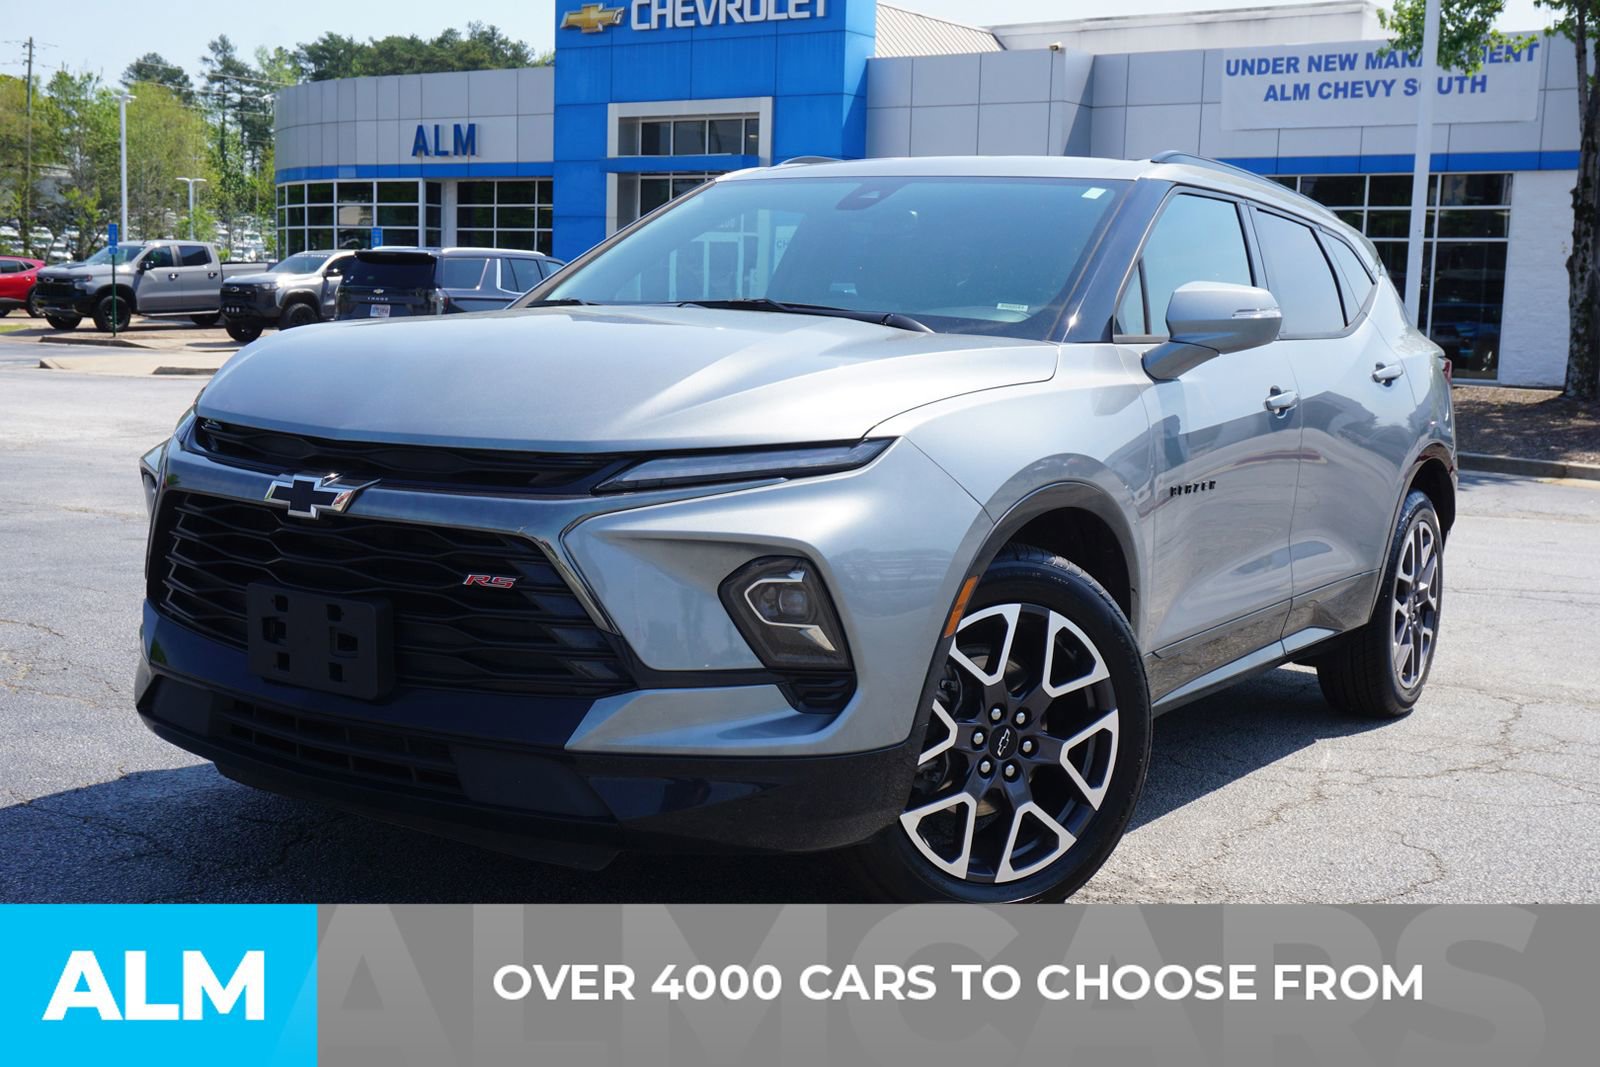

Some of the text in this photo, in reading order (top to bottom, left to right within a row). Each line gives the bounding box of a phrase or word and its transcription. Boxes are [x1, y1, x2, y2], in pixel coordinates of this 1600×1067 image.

[1226, 43, 1540, 76] UNDER NEW MANENT
[1264, 75, 1487, 102] ALM CHEVY SUTH
[411, 123, 476, 157] ALM
[462, 574, 517, 589] RS
